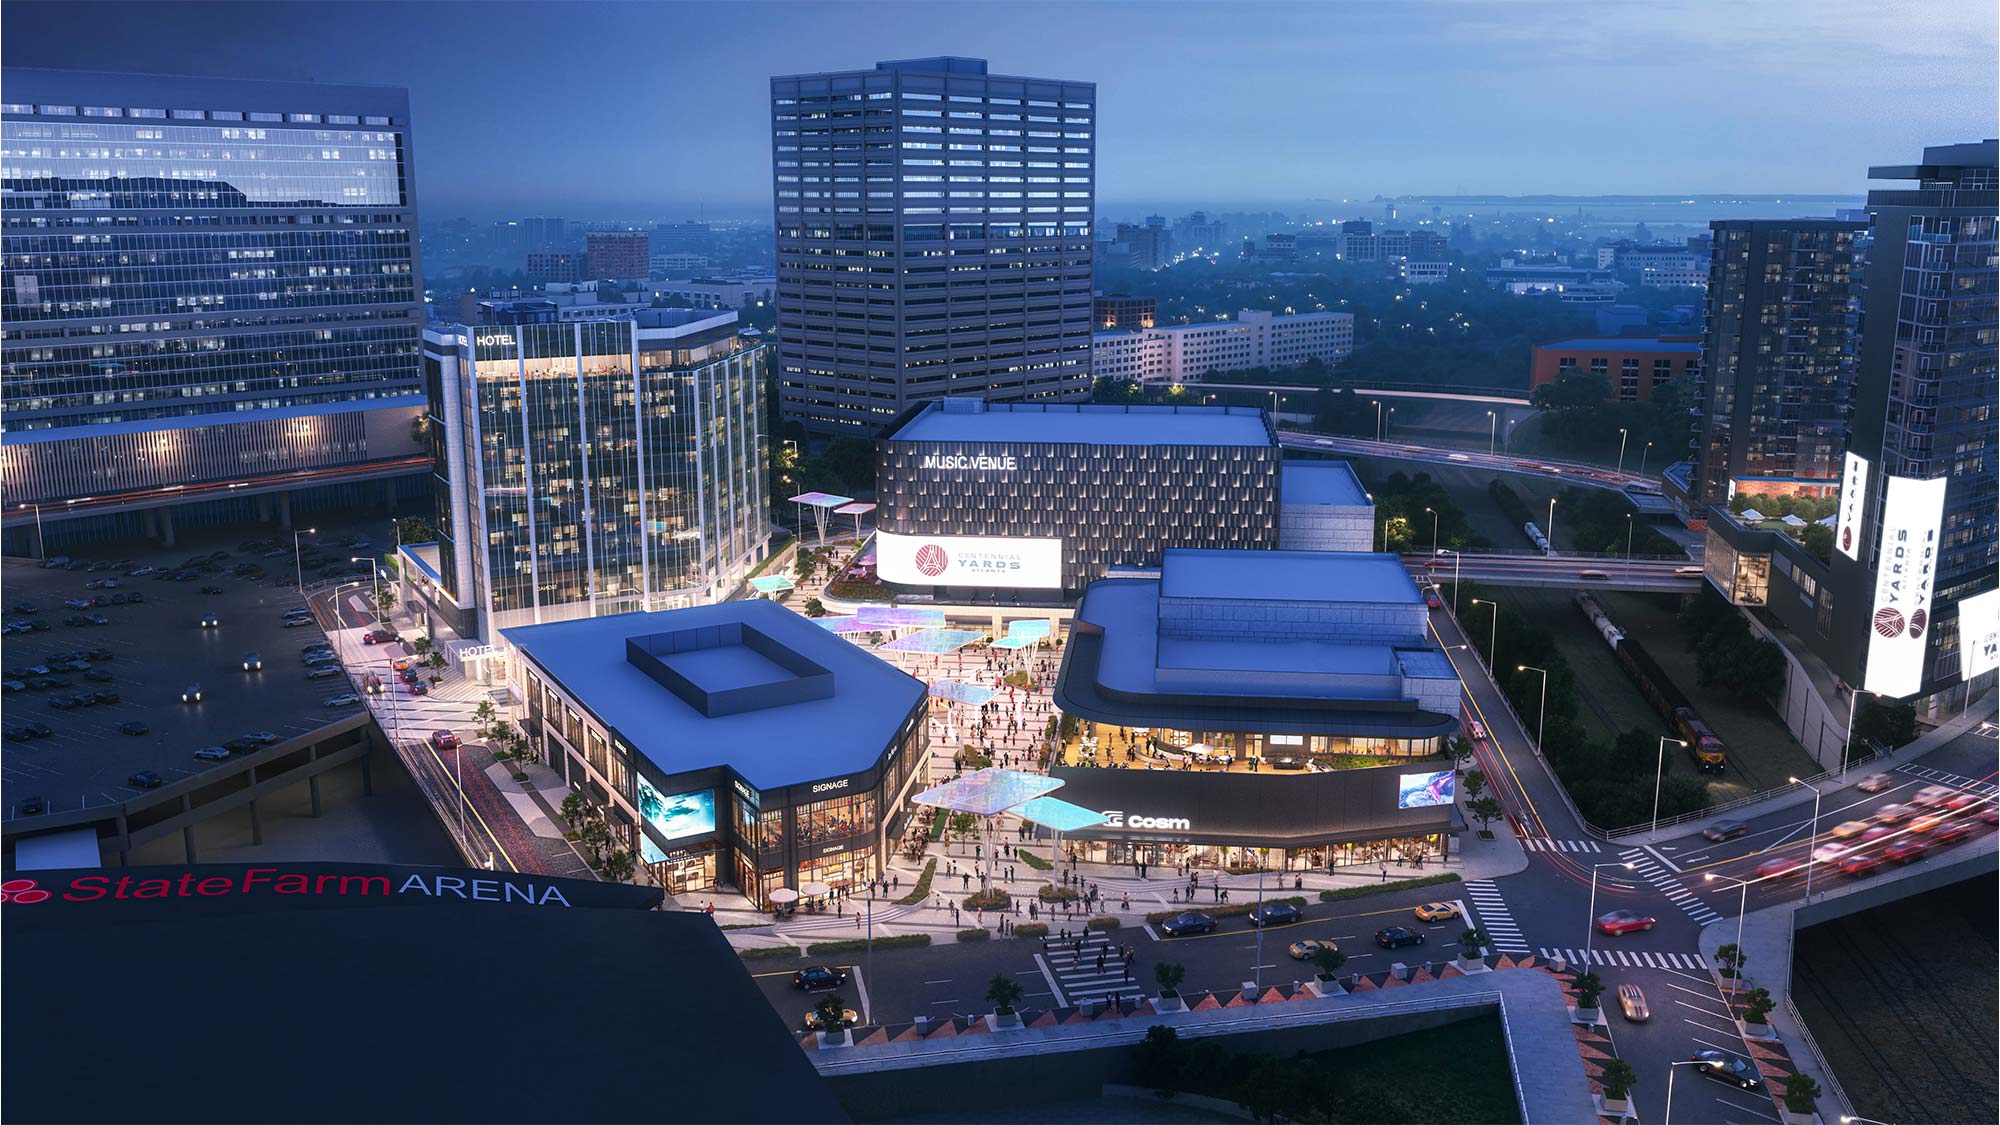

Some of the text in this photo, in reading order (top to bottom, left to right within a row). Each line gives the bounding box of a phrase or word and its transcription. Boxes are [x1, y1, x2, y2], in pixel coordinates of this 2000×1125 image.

[476, 334, 516, 347] HOTEL
[925, 455, 1018, 471] MUSIC VENUE
[958, 552, 1021, 561] CENTENNIAL
[958, 559, 1021, 569] YARDS
[1881, 526, 1897, 603] CENTENNIAL
[1889, 529, 1908, 604] YARDS
[1902, 548, 1911, 590] ATLANTA
[1919, 529, 1934, 605] YARDS
[812, 779, 849, 793] SIGNAGE
[1128, 815, 1190, 830] Cosm
[823, 844, 845, 854] SIGNAGE
[62, 868, 571, 908] State Farm ARENA
